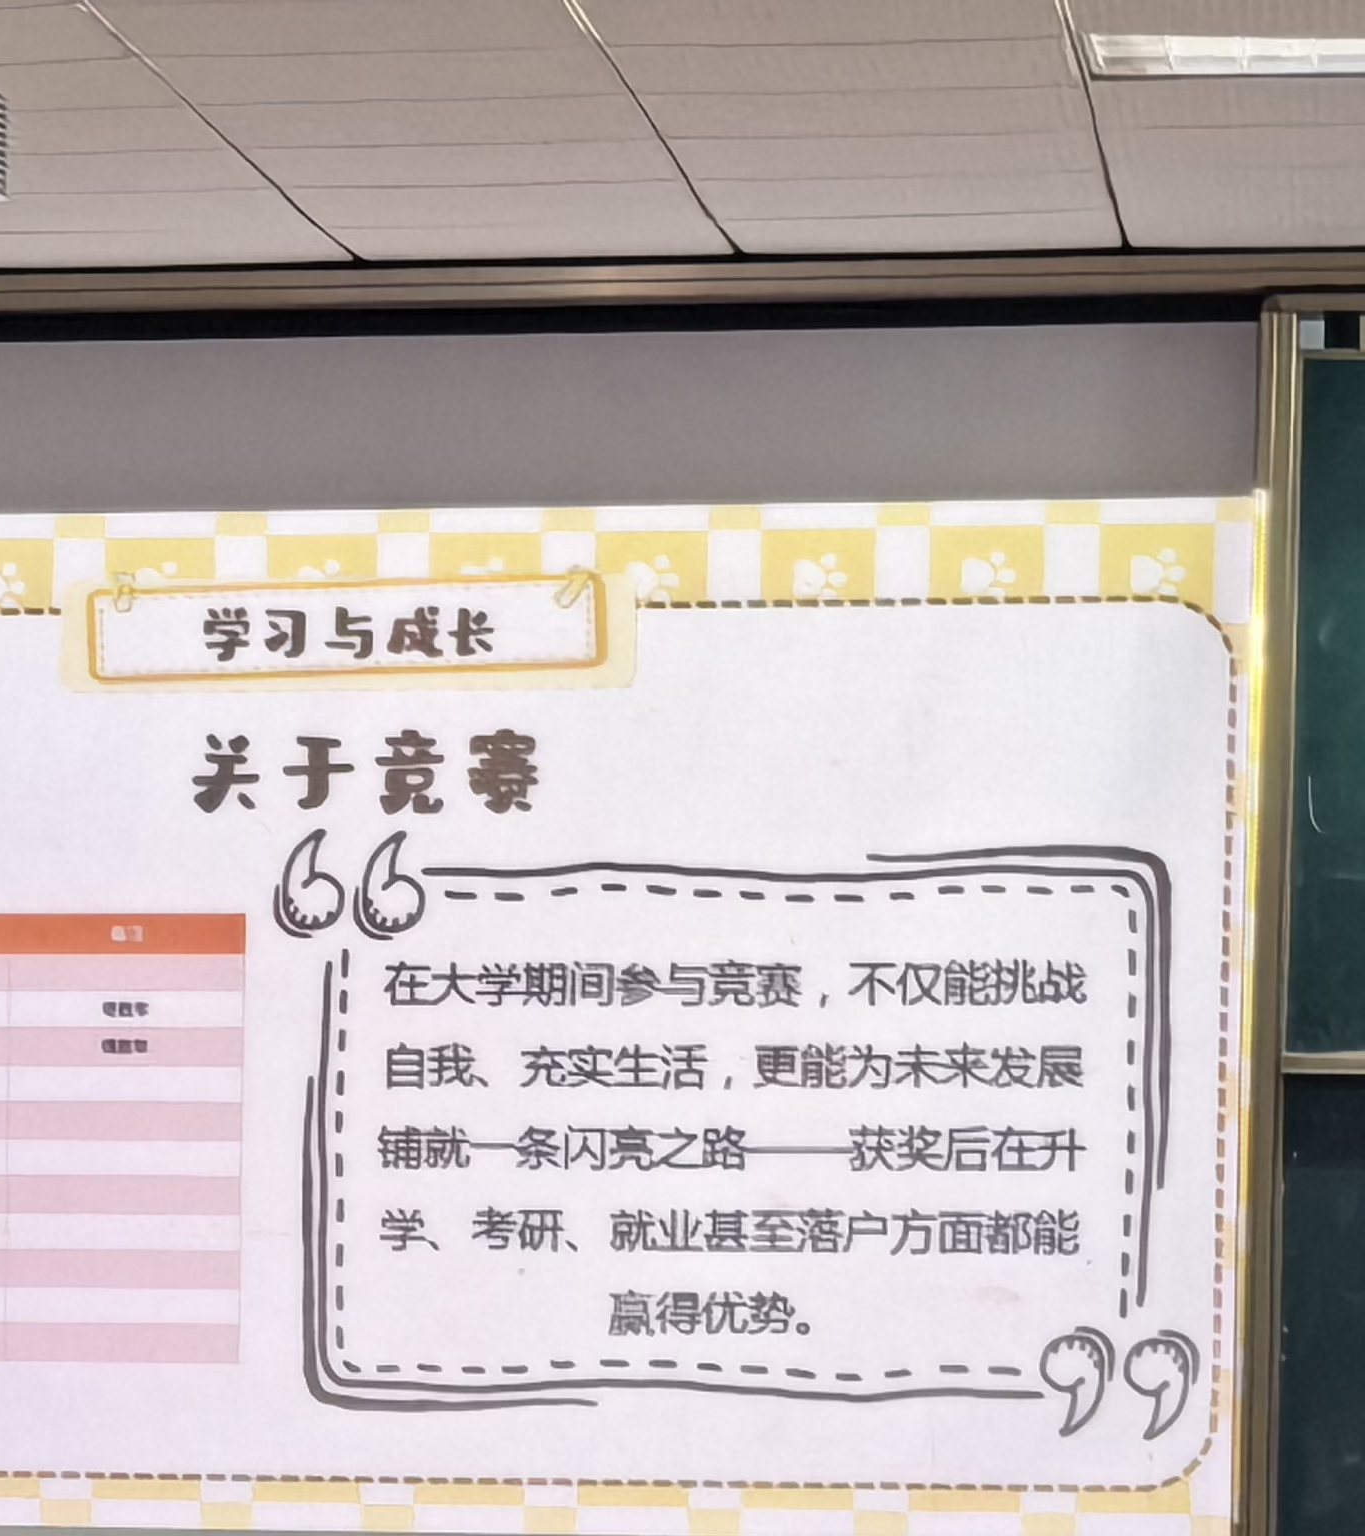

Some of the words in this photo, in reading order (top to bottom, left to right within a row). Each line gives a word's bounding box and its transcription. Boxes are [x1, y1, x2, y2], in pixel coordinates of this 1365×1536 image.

[202, 605, 495, 661] 学习与成长
[191, 728, 540, 815] 关于竞赛
[383, 957, 1088, 1009] 在大学期间参与竞赛，不仅能挑战
[385, 1040, 1085, 1091] 自我、充实生活，更能为未来发展
[376, 1123, 1088, 1173] 铺就一条闪亮之路——获奖后在升
[379, 1205, 1081, 1257] 学、考研、就业甚至落户方面都能
[607, 1288, 811, 1338] 赢得优势。
